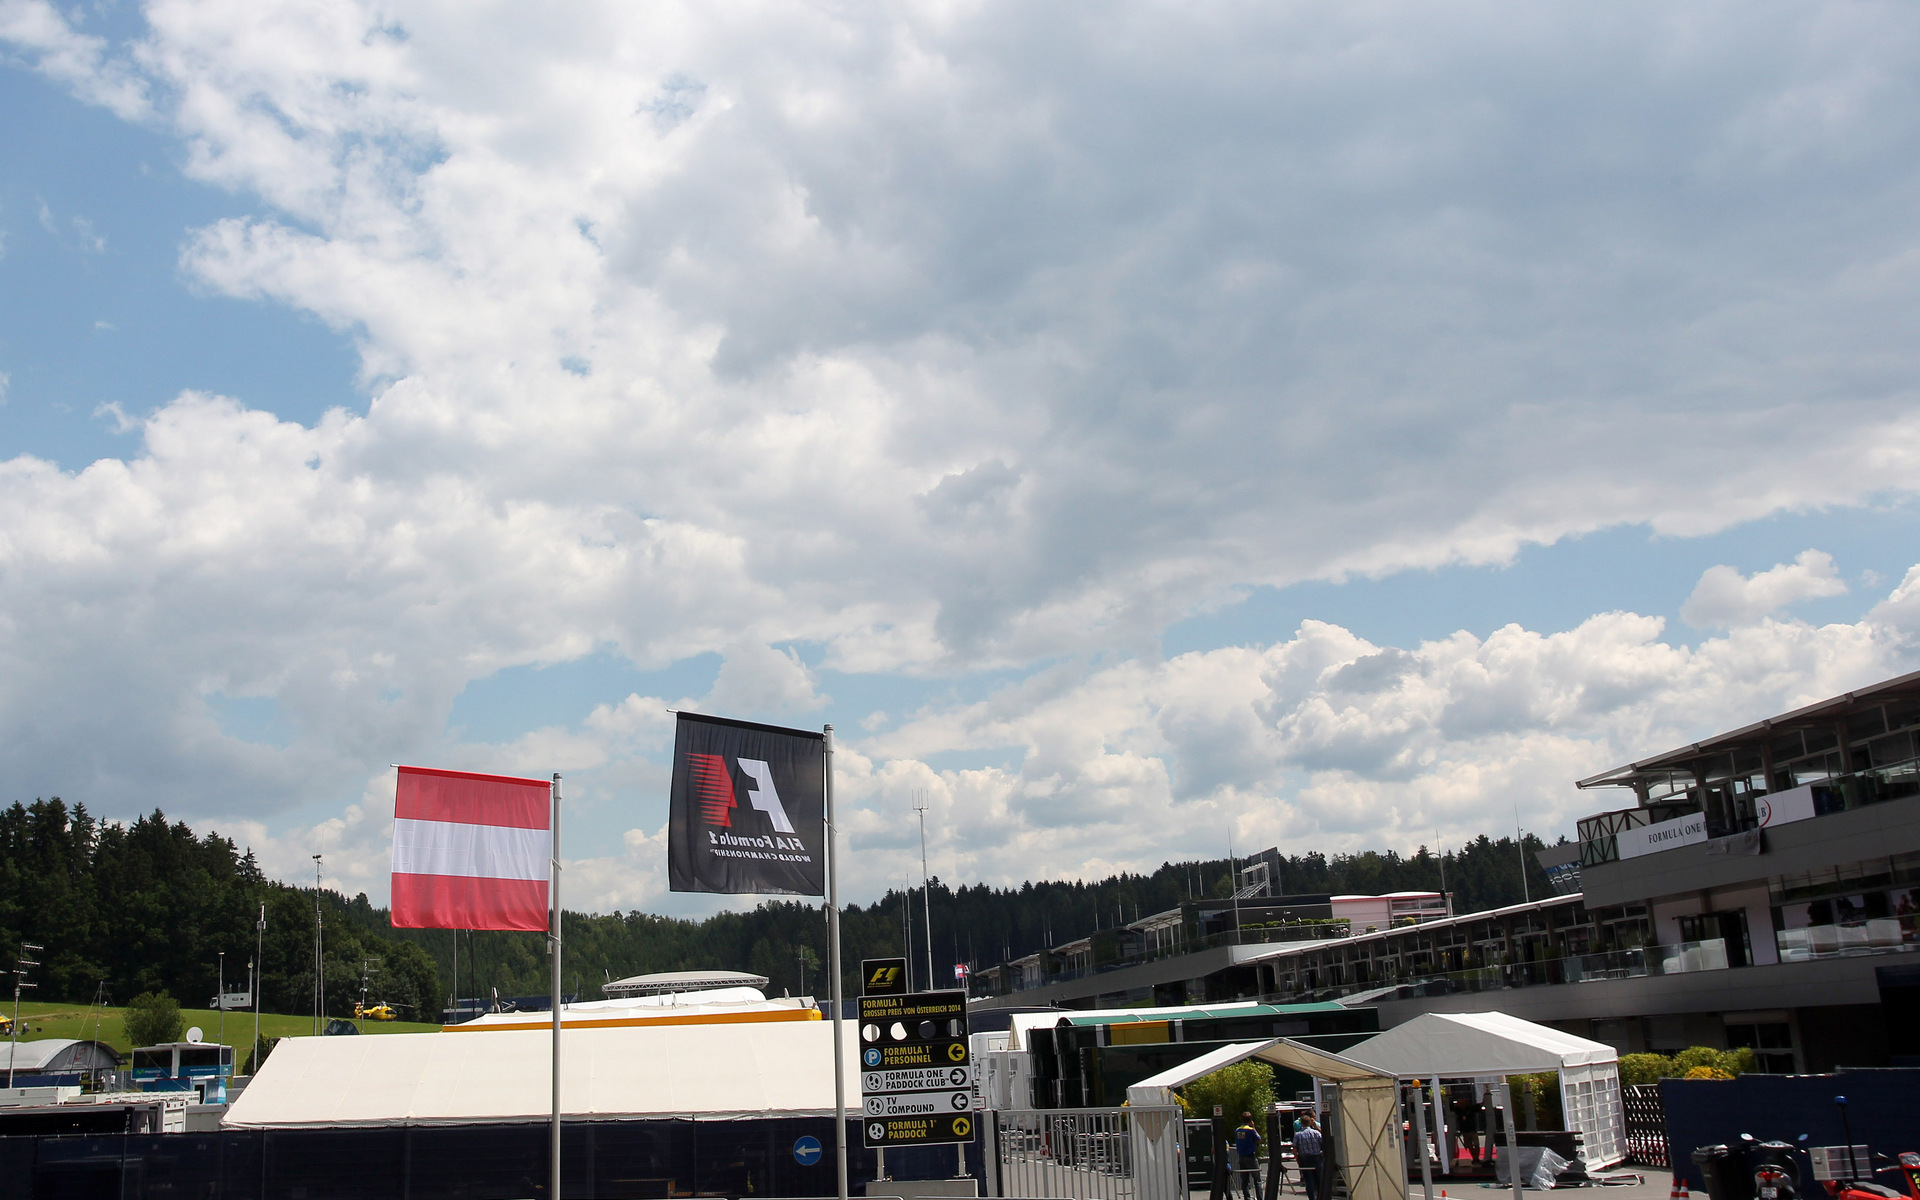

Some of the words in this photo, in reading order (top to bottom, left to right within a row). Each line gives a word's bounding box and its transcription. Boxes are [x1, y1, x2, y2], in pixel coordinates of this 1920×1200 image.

[1648, 827, 1684, 844] FORMULA
[1685, 822, 1702, 835] ONE
[870, 967, 900, 983] F1
[863, 999, 898, 1009] FORMULA
[899, 998, 904, 1006] 1
[863, 1008, 887, 1018] GROSSER
[887, 1007, 902, 1016] PREIS
[903, 1006, 916, 1015] VON
[916, 1003, 947, 1014] ÖSTERREICH
[948, 1004, 961, 1012] 2014
[883, 1046, 923, 1056] FORMULA
[884, 1054, 932, 1066] PERSONNEL
[885, 1070, 924, 1081] FORMULA
[926, 1069, 944, 1078] ONE
[885, 1079, 924, 1090] PADDOCK
[886, 1096, 898, 1105] TV
[887, 1103, 935, 1115] COMPOUND
[887, 1121, 928, 1131] FORMULA
[888, 1129, 927, 1140] PADDOCK
